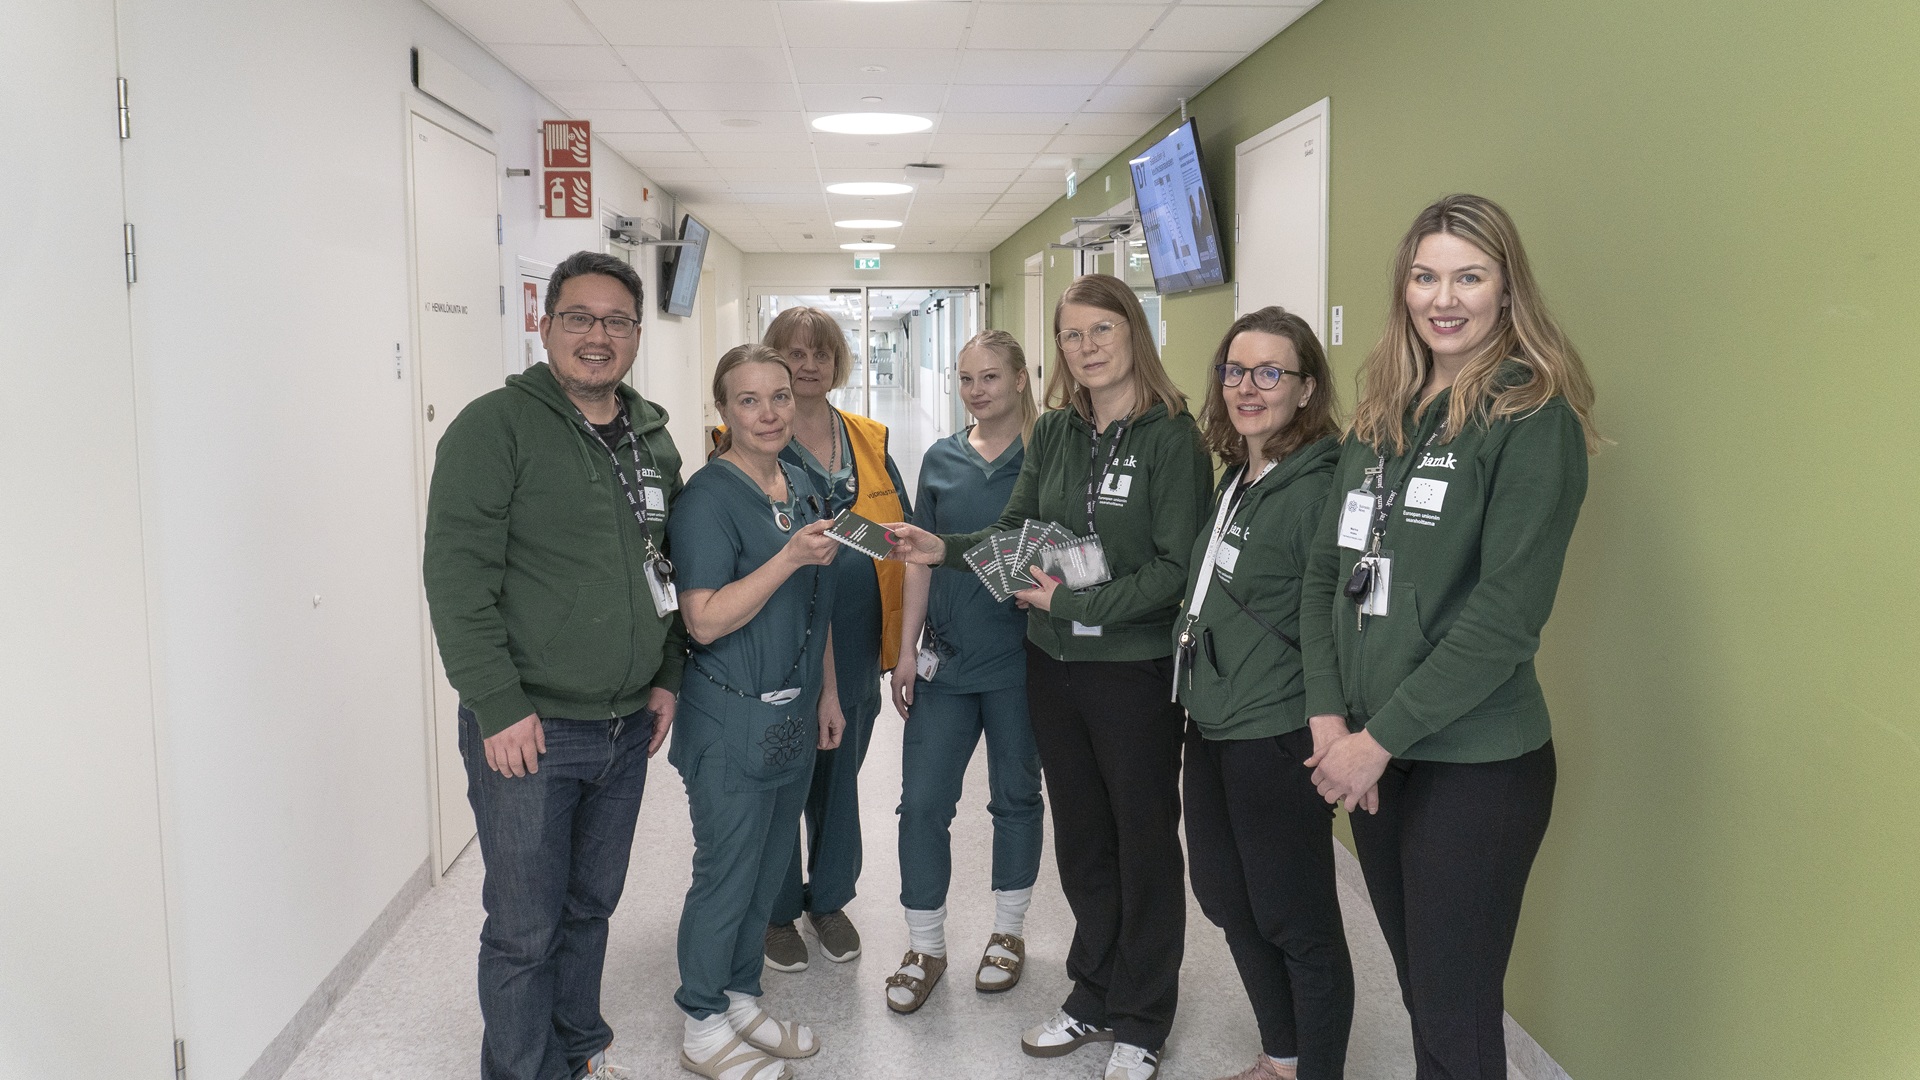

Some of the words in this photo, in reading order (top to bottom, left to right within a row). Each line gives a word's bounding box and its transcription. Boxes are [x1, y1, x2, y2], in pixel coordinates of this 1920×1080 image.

[1135, 161, 1147, 189] D7
[1417, 452, 1457, 470] jamk
[1386, 490, 1397, 506] jamk
